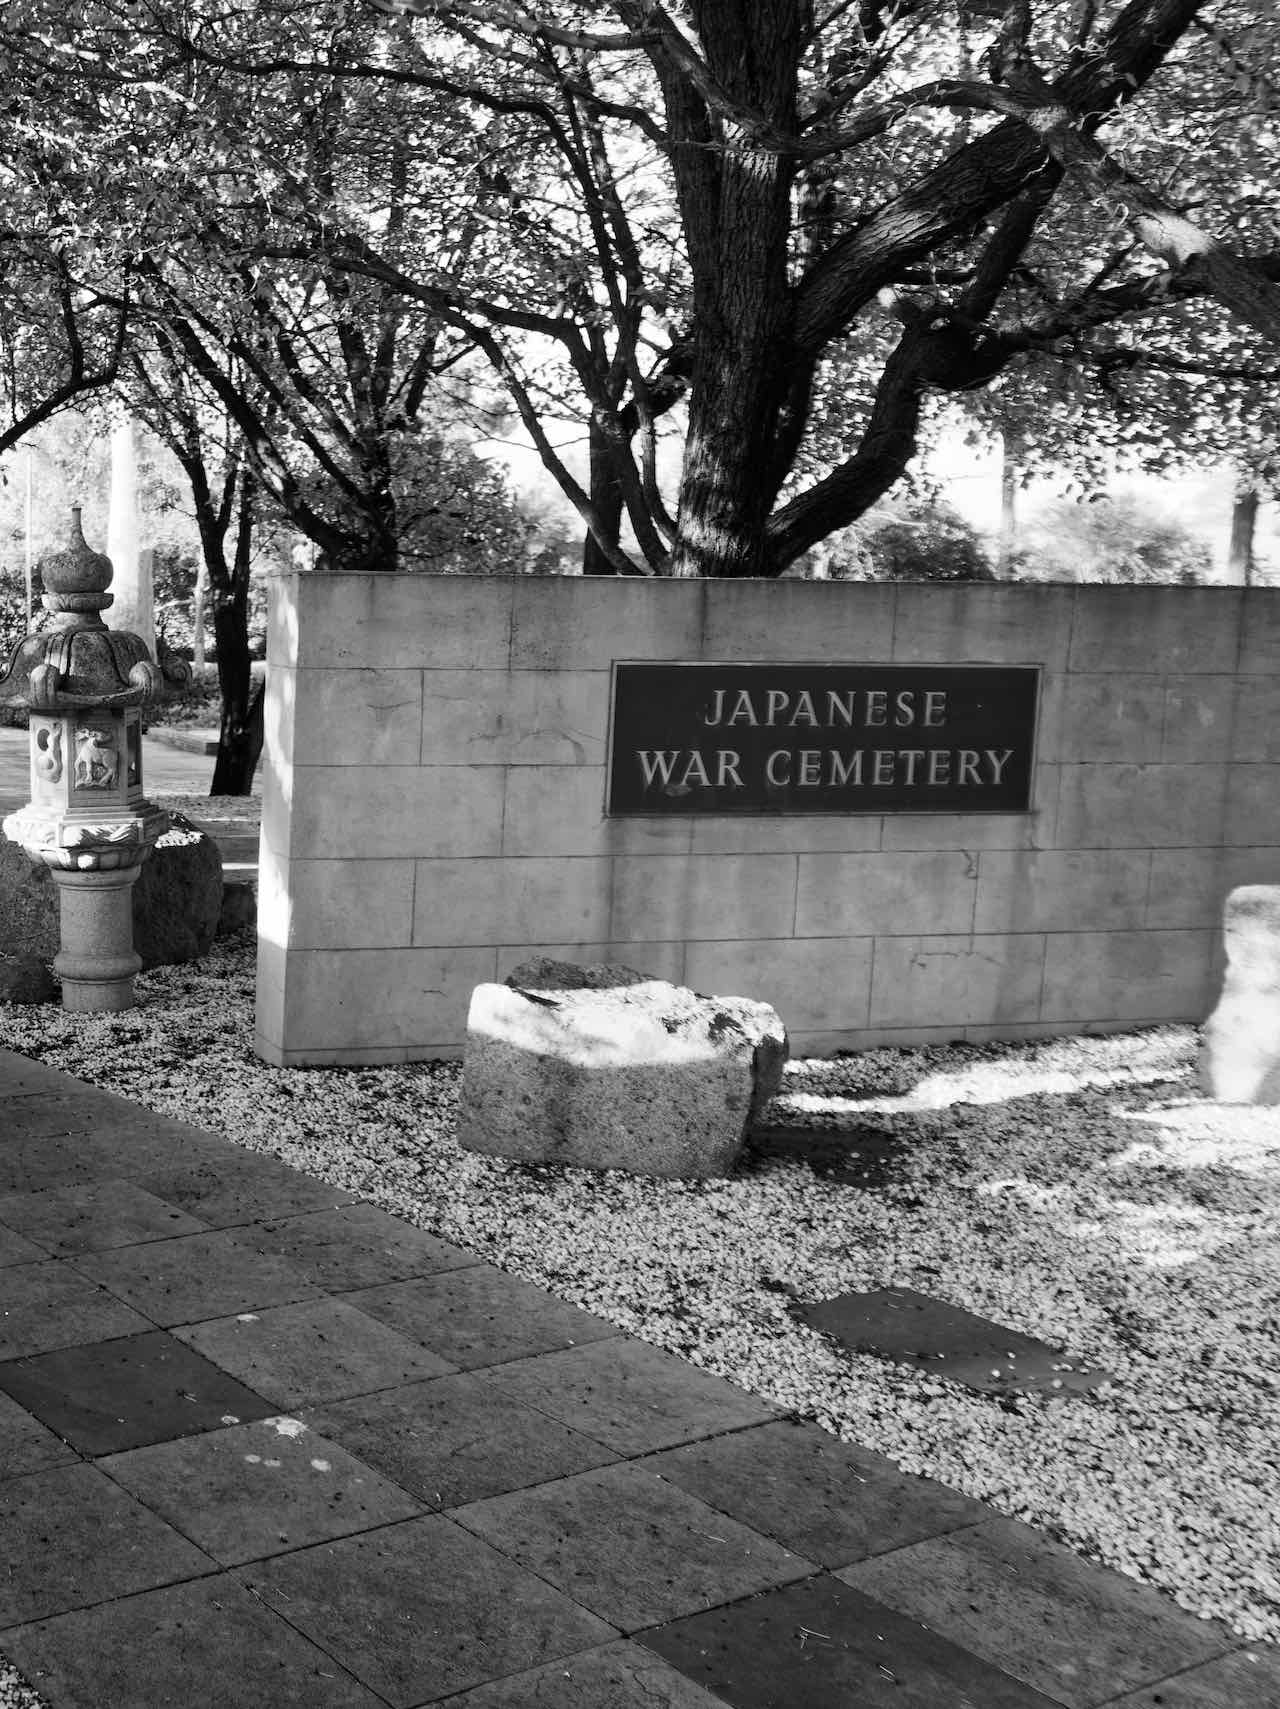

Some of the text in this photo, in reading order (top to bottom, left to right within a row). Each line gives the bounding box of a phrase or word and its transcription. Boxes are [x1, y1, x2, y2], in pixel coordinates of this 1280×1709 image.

[704, 690, 947, 727] JAPANESE
[637, 750, 1014, 787] WAR CEMETERY
